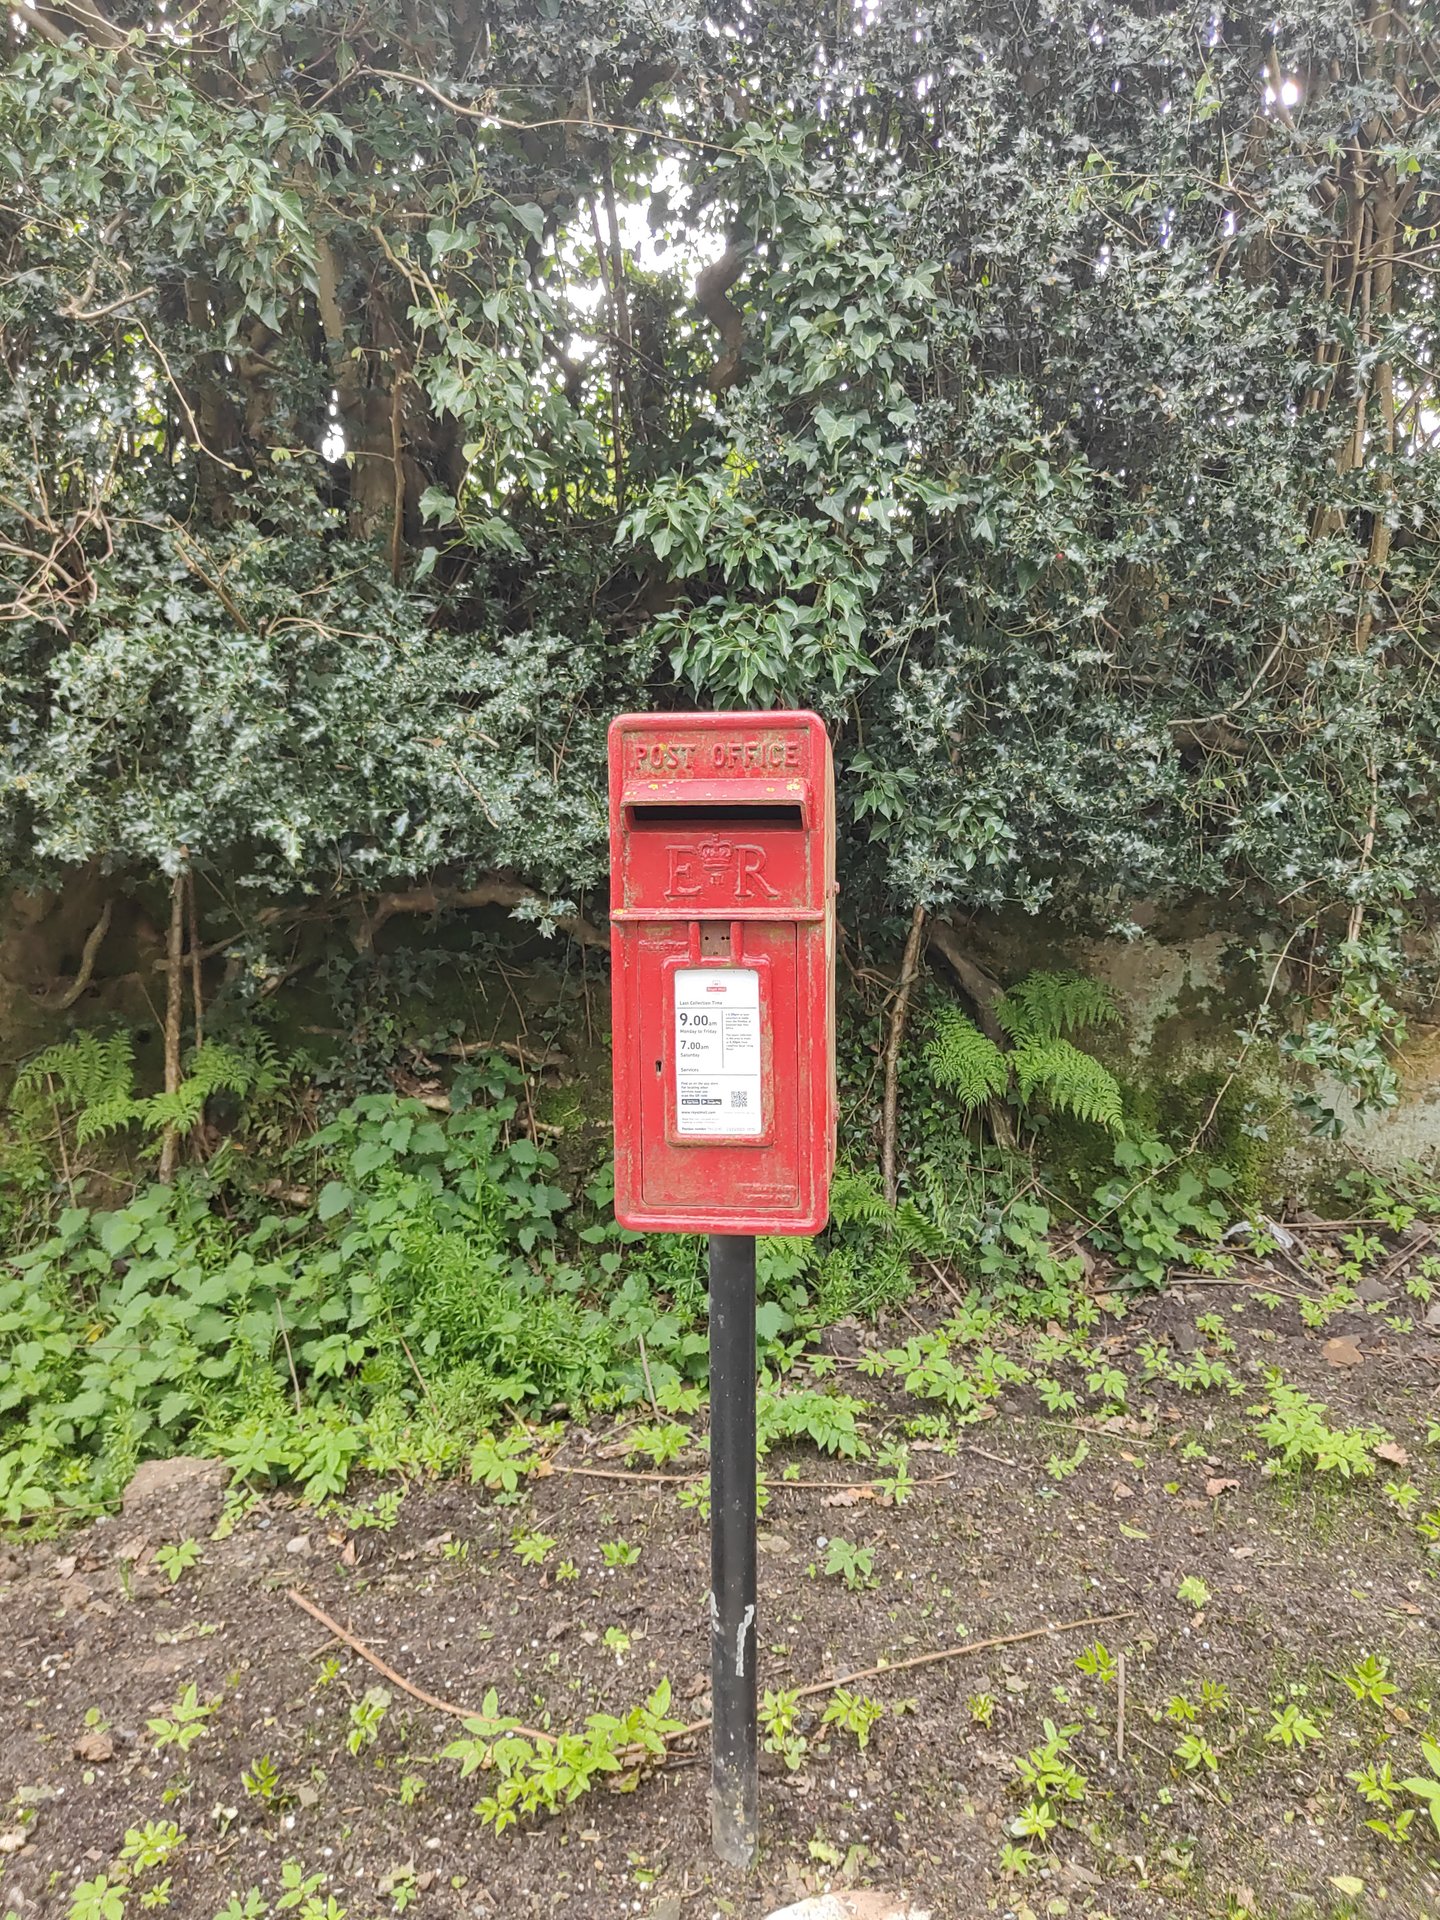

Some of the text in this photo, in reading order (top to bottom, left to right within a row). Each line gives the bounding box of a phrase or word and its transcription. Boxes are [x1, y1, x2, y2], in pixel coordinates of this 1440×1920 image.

[634, 742, 799, 770] POST OFFICE
[664, 844, 780, 900] E R
